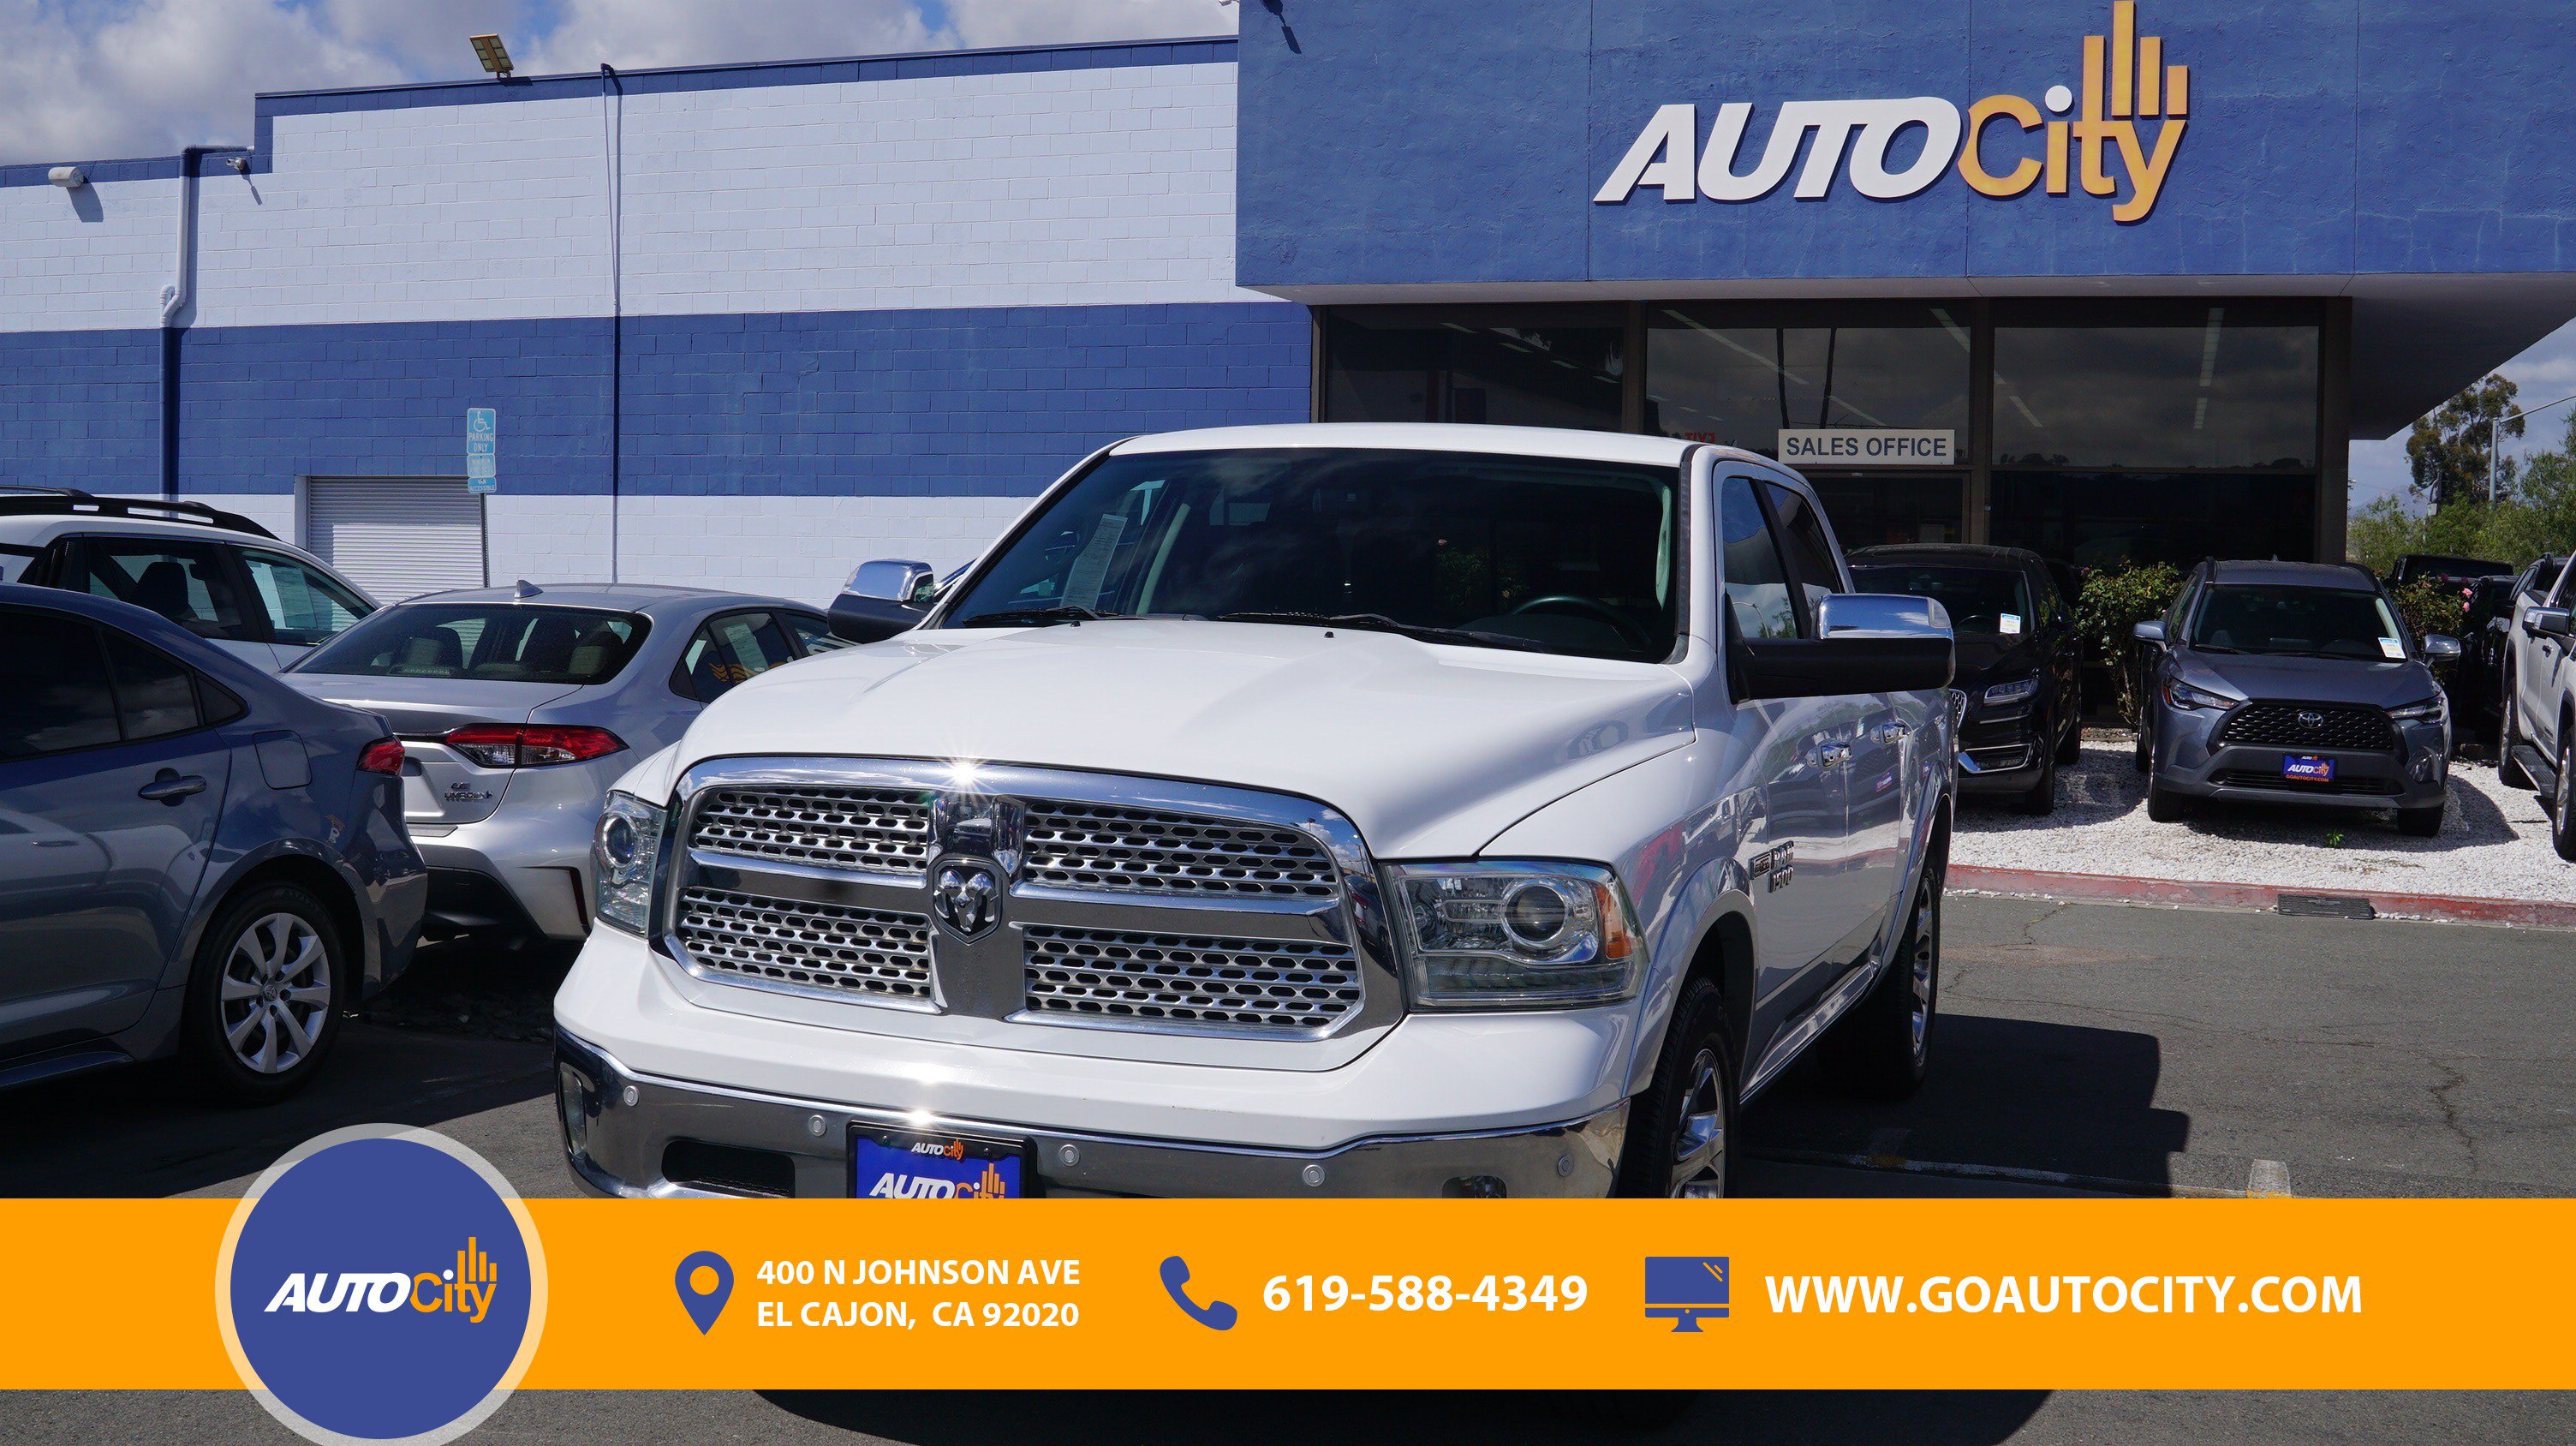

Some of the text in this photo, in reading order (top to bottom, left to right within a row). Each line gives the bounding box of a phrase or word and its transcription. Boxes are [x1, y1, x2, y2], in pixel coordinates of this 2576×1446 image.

[1594, 21, 2189, 223] AUTOCity
[468, 433, 493, 442] PARKING
[473, 442, 489, 452] ONLY
[1786, 437, 1947, 457] SALES OFFICE
[2287, 762, 2329, 776] AUTOCity
[2286, 774, 2329, 782] GOAUTOCITY.COM
[911, 1138, 964, 1161] AUTOCity
